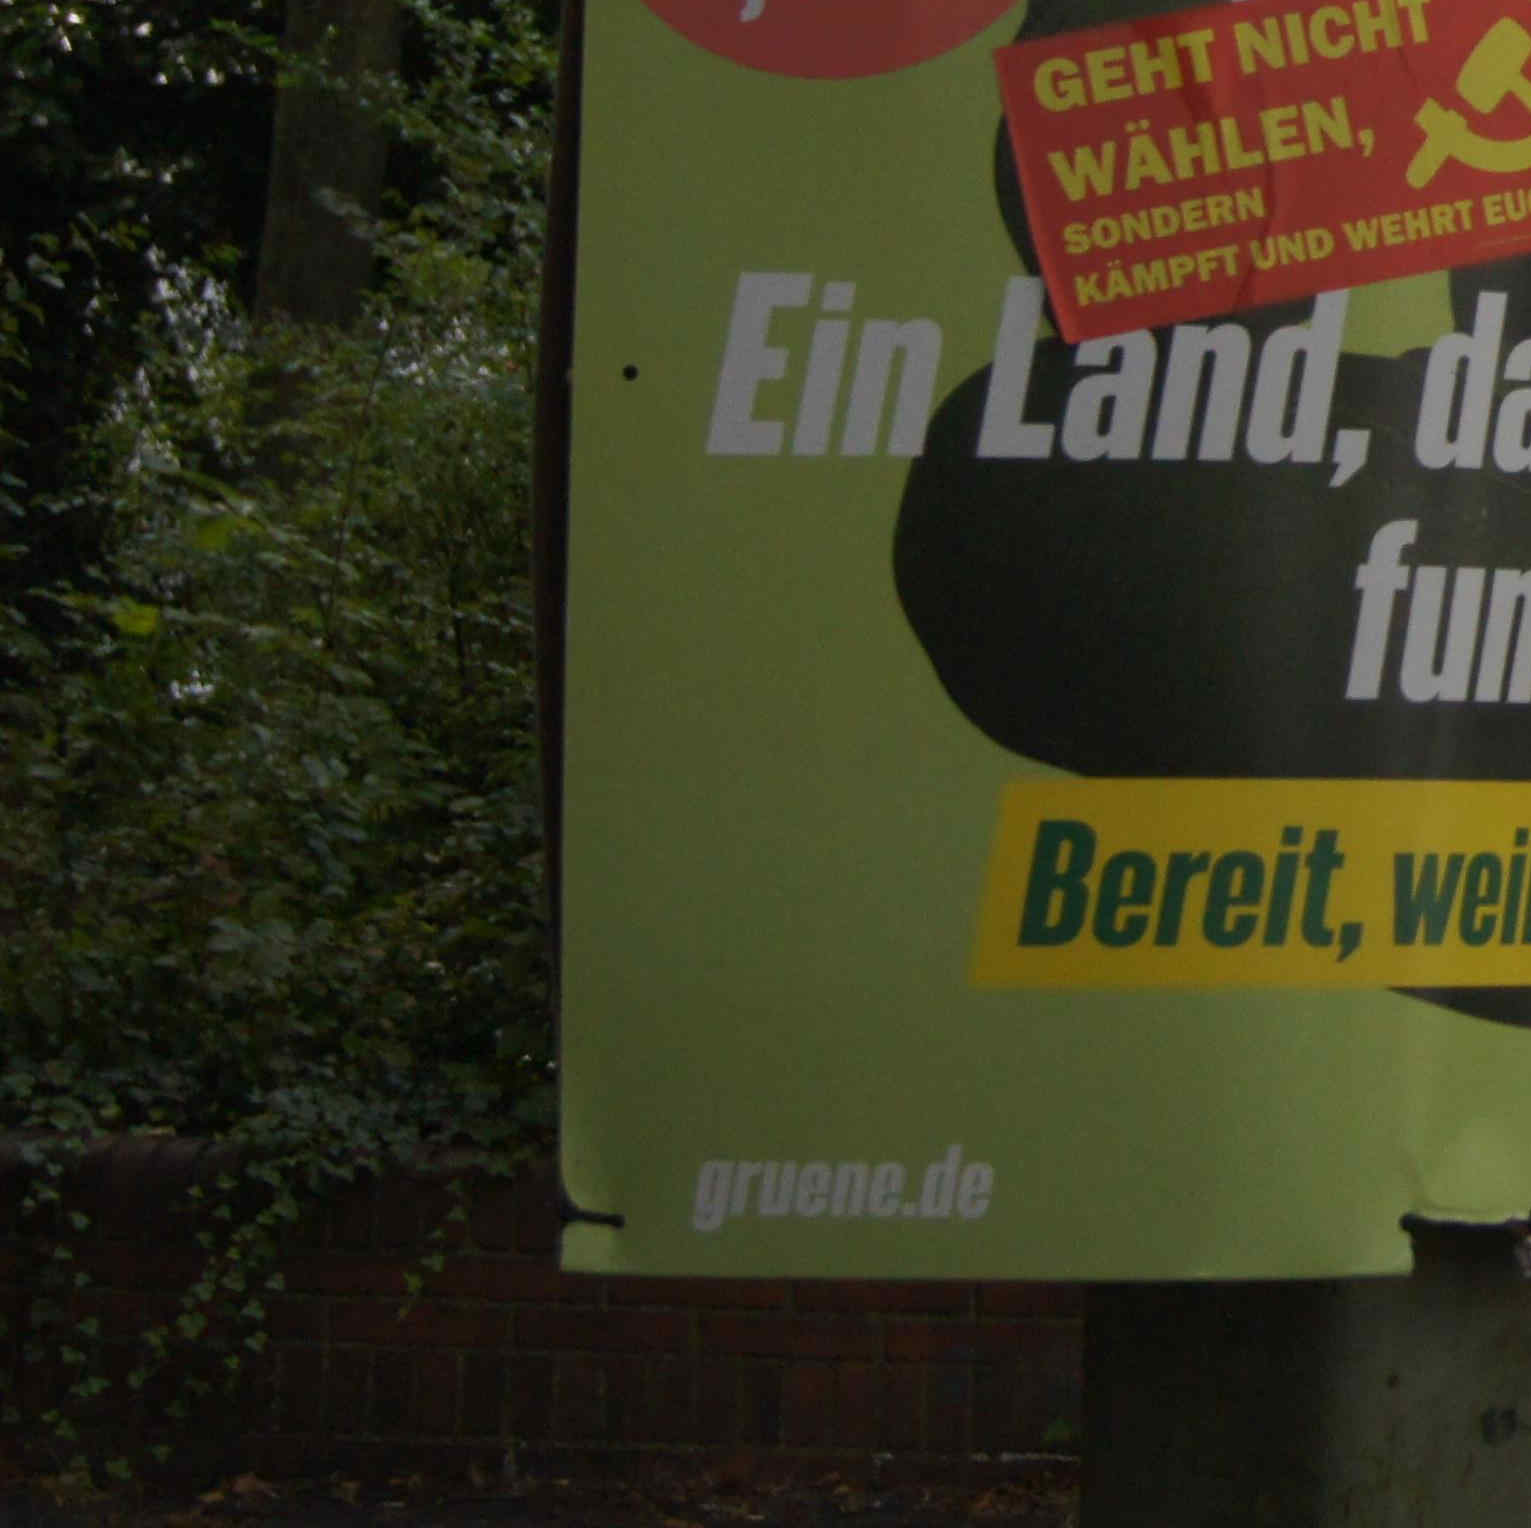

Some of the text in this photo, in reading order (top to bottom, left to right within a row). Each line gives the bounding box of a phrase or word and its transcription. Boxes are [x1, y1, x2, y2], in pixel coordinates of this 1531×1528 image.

[1034, 28, 1215, 113] GEHT
[1047, 96, 1377, 202] WÄHLEN,
[1062, 187, 1266, 256] SONDERN
[1074, 244, 1239, 307] KÄMPFT
[1250, 227, 1335, 272] UND
[1342, 197, 1474, 253] WEHRT
[706, 270, 944, 458] Ein
[975, 274, 1371, 488] Land,
[1016, 819, 1364, 963] Bereit,
[691, 1143, 995, 1233] gruene.de
